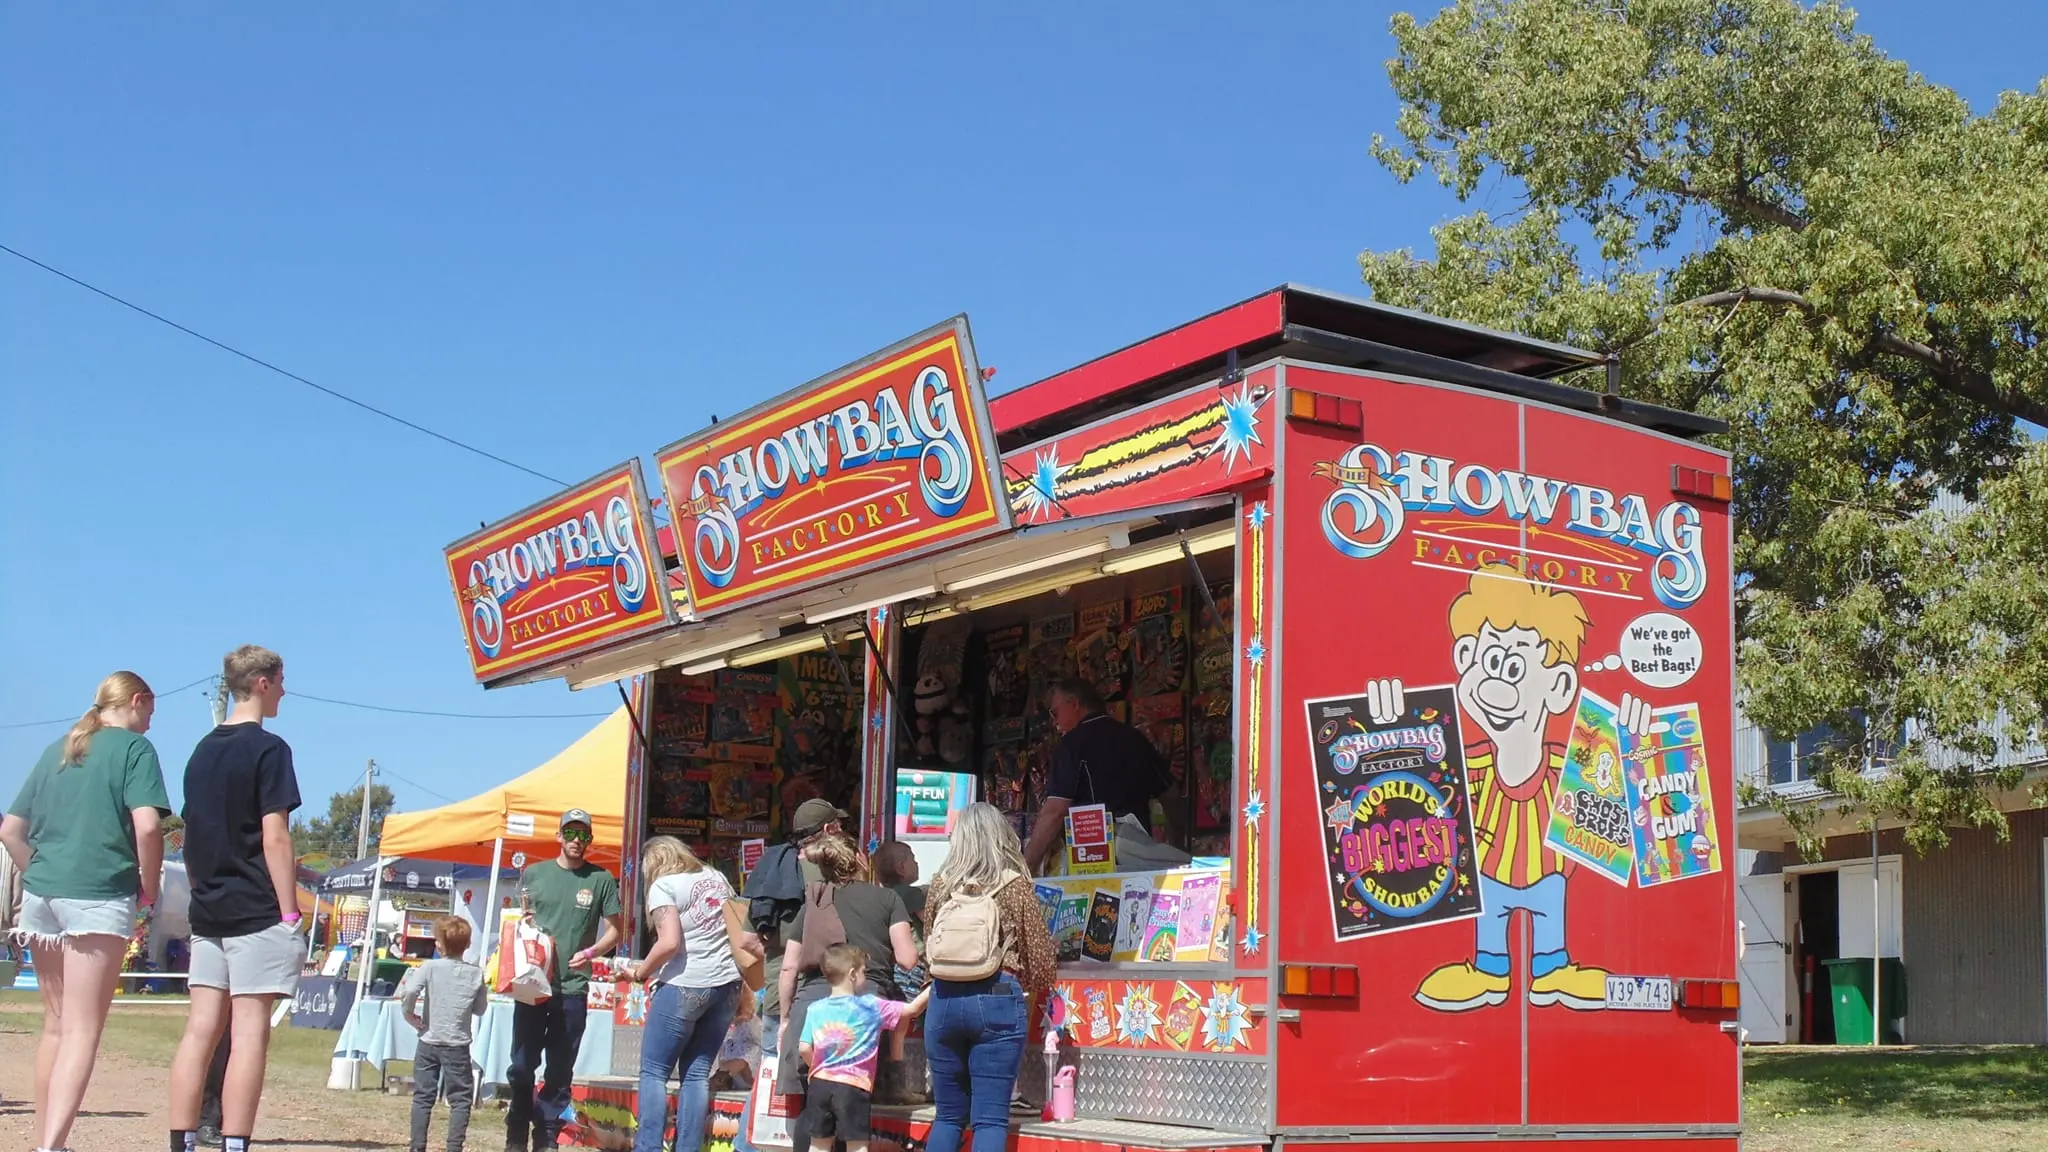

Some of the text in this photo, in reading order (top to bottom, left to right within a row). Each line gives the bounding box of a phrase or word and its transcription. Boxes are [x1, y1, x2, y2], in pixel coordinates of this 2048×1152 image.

[694, 364, 974, 588] SHOWBAG
[752, 492, 912, 565] FACTORY
[1320, 443, 1707, 608] THE SHOWBAG
[471, 495, 647, 658] SHOWBAG
[1415, 538, 1633, 592] FACTORY
[510, 591, 610, 643] FACTORY
[1631, 627, 1691, 643] We've got
[1631, 657, 1696, 674] Best Bags!
[1653, 642, 1672, 656] the
[1331, 724, 1446, 775] SHOWBAG
[1361, 756, 1424, 773] FACTORY
[1628, 745, 1658, 761] Cosmic
[922, 787, 945, 800] FUN
[1353, 778, 1440, 823] WORLDS
[1638, 771, 1696, 801] CANDY
[1341, 817, 1458, 873] BIGGEST
[1565, 825, 1617, 865] CANDY
[1651, 813, 1697, 840] GUM
[1363, 866, 1448, 909] SHOWBAG
[1608, 981, 1670, 1002] V39 743
